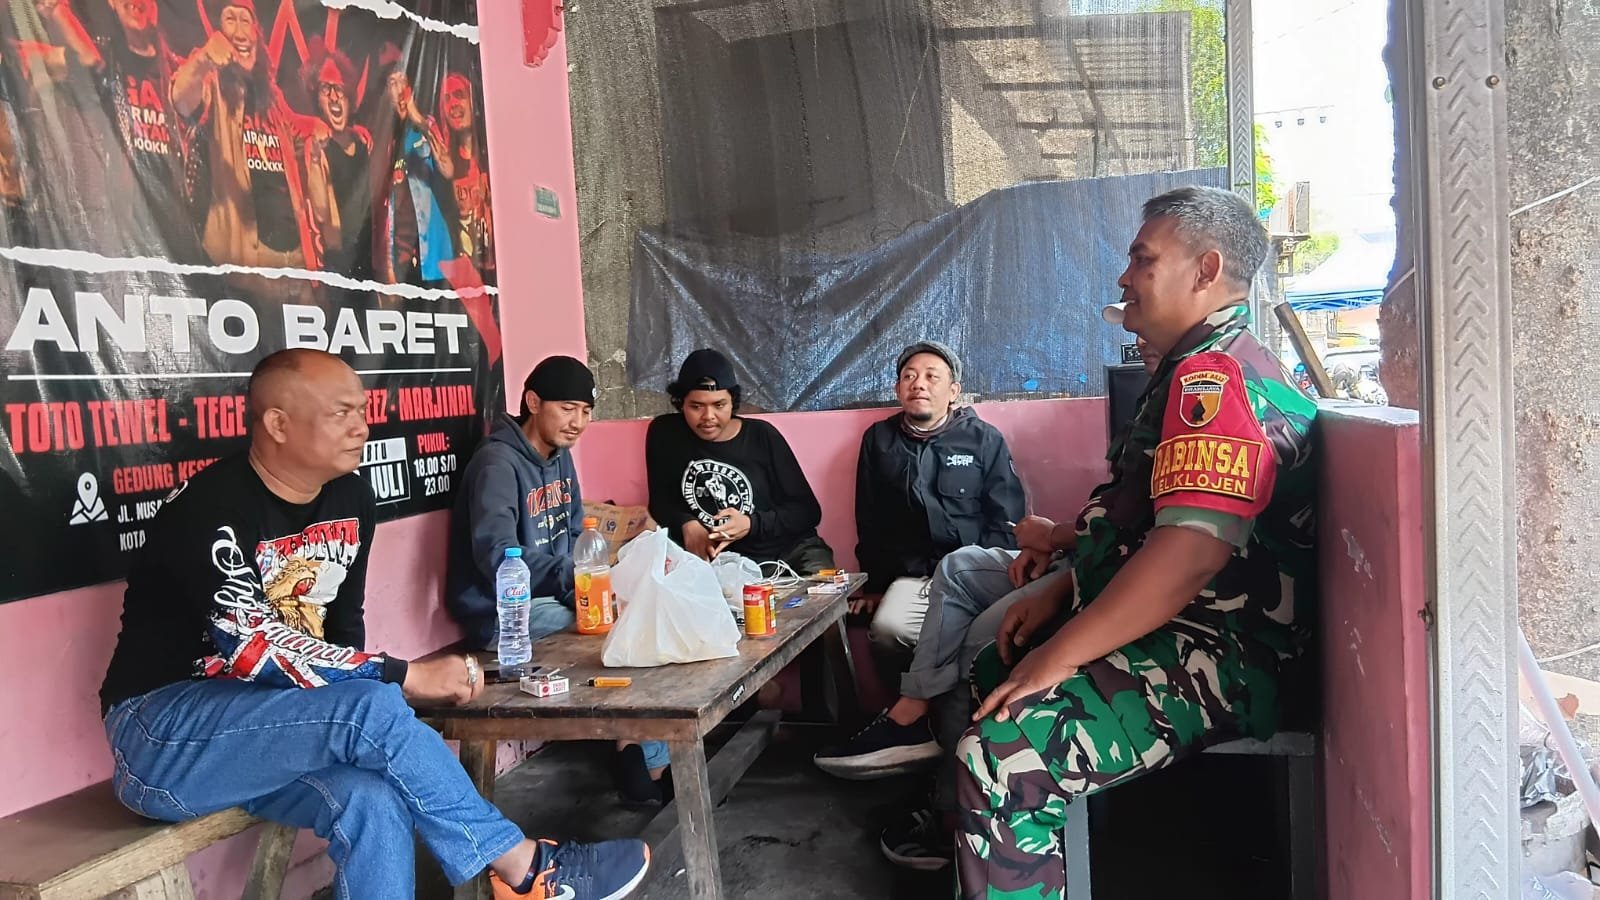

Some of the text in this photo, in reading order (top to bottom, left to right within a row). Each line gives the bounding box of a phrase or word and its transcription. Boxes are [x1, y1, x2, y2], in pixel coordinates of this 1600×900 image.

[5, 287, 468, 355] ANTO BARET
[5, 401, 85, 454] TOTO
[87, 398, 172, 448] TEWEL
[194, 395, 247, 439] TEGE
[398, 385, 476, 421] MARJINAL
[417, 432, 450, 455] PUKUL:
[413, 454, 457, 478] 18.00 S/D
[112, 462, 174, 495] GEDUNG
[424, 474, 450, 497] 23.00
[1154, 473, 1247, 495] EL.KLOJEN
[117, 504, 134, 524] JL.
